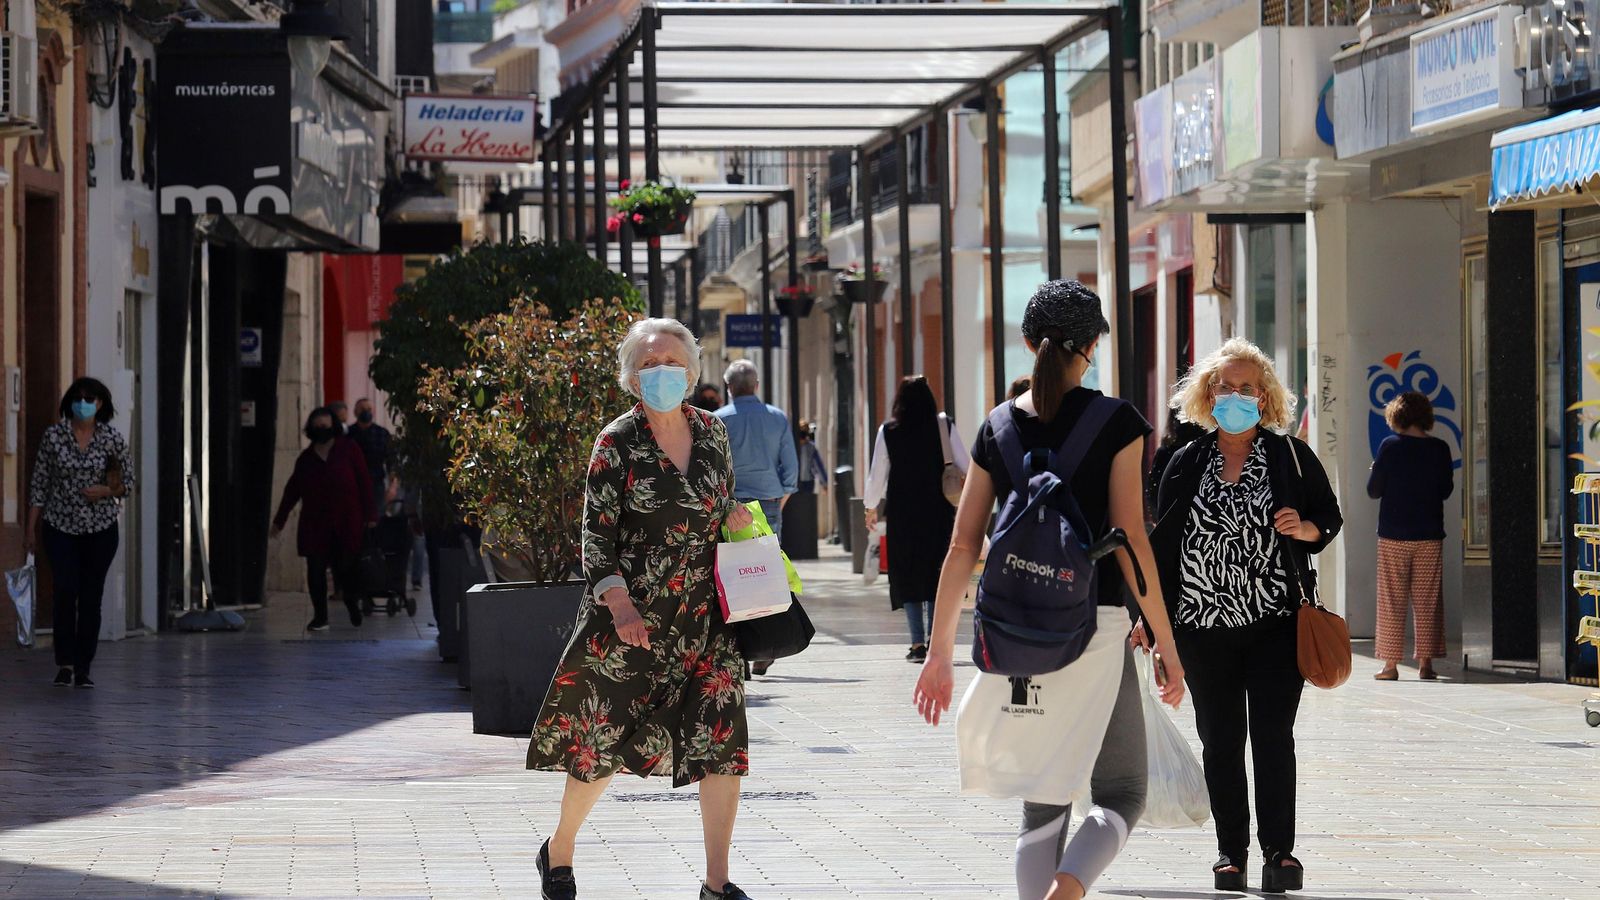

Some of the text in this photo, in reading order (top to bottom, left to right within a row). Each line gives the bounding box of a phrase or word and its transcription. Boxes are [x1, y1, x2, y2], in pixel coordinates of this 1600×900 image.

[1418, 28, 1457, 79] MUNDO
[1453, 76, 1462, 98] de
[409, 126, 446, 154] La
[731, 322, 777, 333] NOTAA
[739, 565, 767, 575] DRUNI
[1005, 553, 1056, 578] Reebok
[1011, 707, 1045, 716] LAGERFELD
